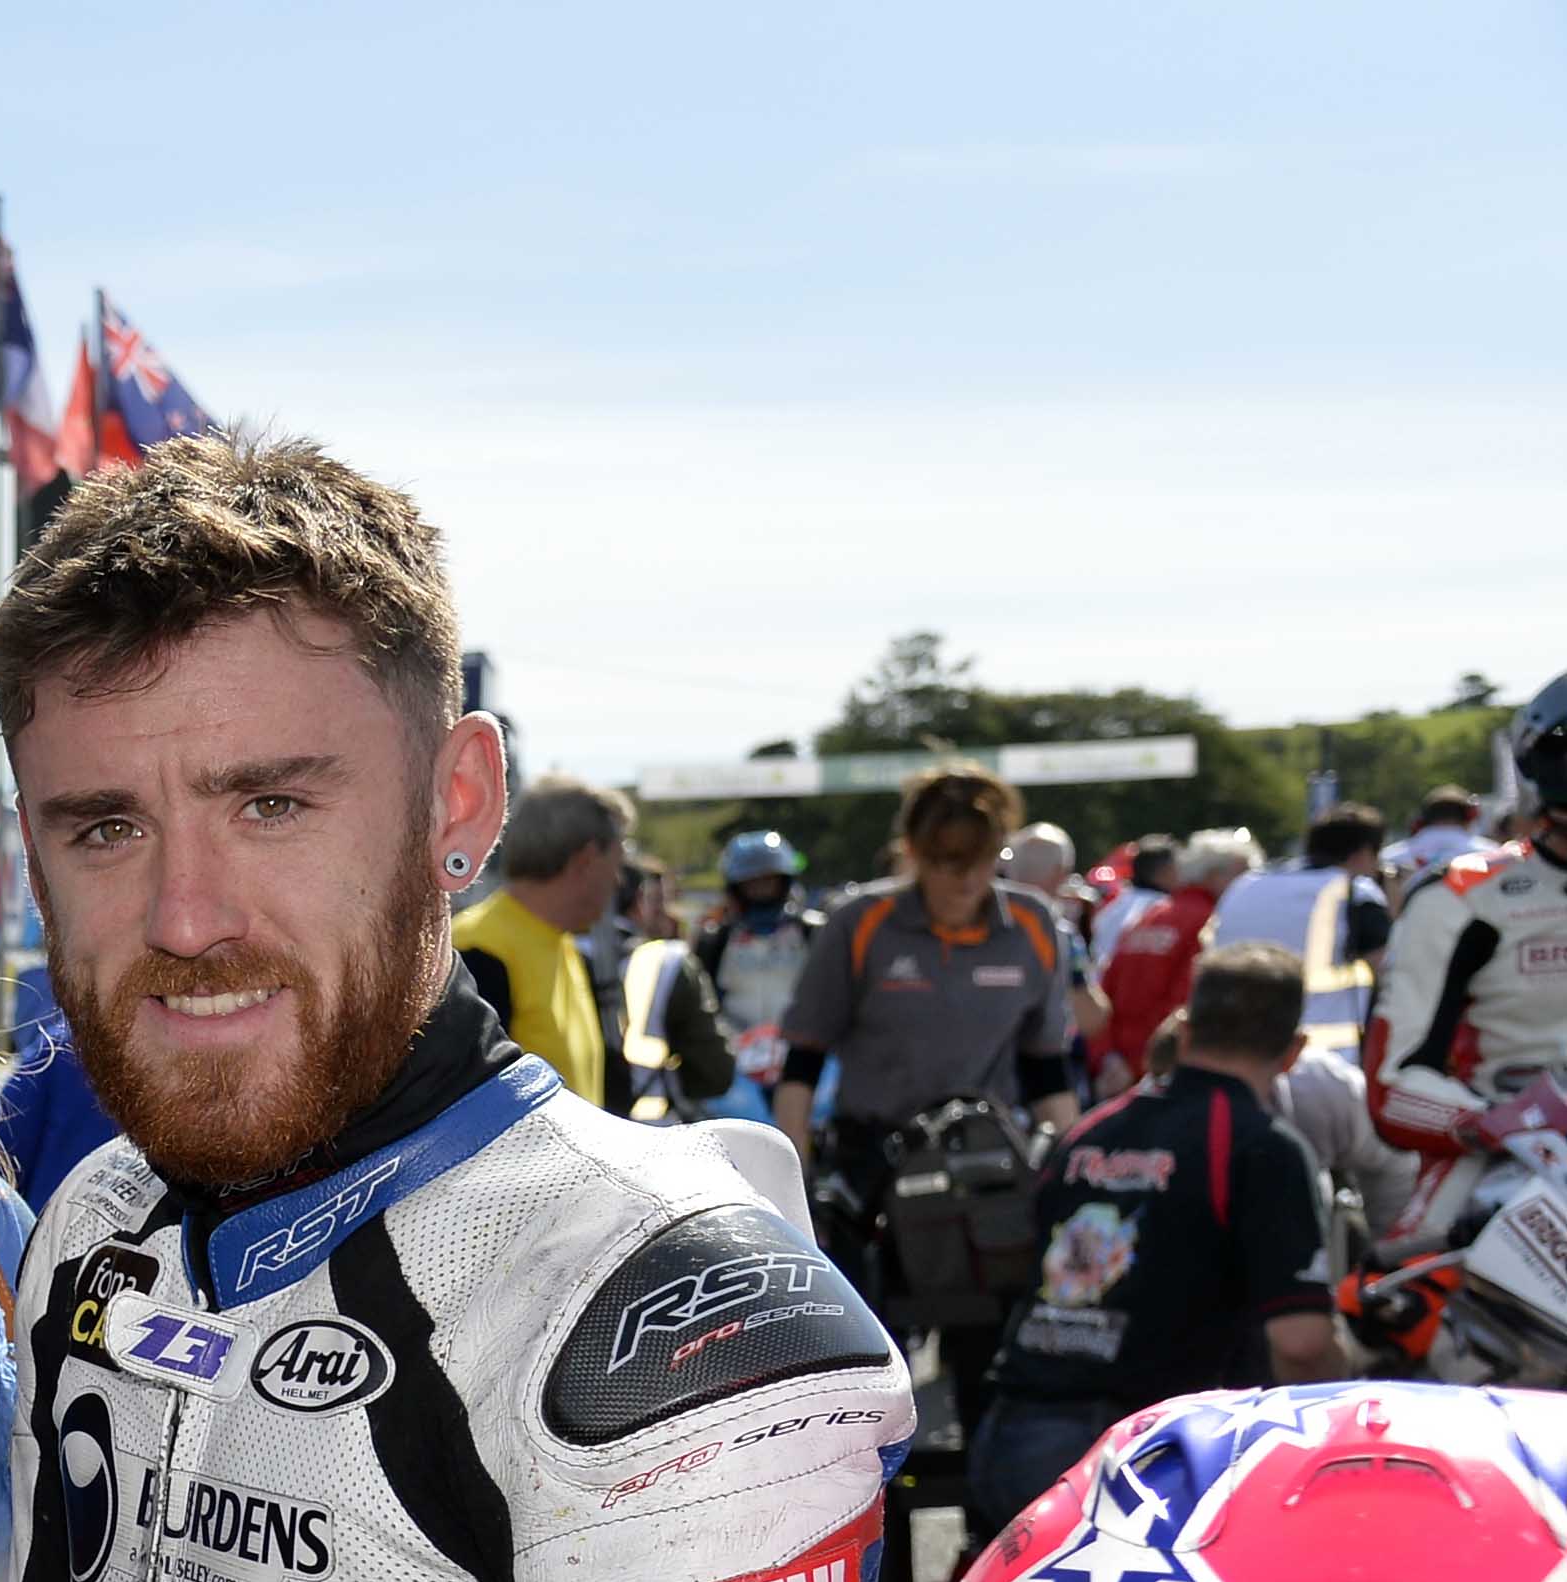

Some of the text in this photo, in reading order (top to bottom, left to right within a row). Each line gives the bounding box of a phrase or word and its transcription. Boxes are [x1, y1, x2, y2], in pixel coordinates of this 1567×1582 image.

[235, 1155, 401, 1293] RST
[71, 1301, 109, 1344] CA
[124, 1313, 237, 1382] 13
[607, 1252, 832, 1375] RST
[671, 1301, 845, 1372] pro series
[258, 1329, 365, 1385] Arai
[280, 1386, 332, 1402] HELMET
[602, 1406, 888, 1509] pro series
[136, 1467, 331, 1575] BURDENS
